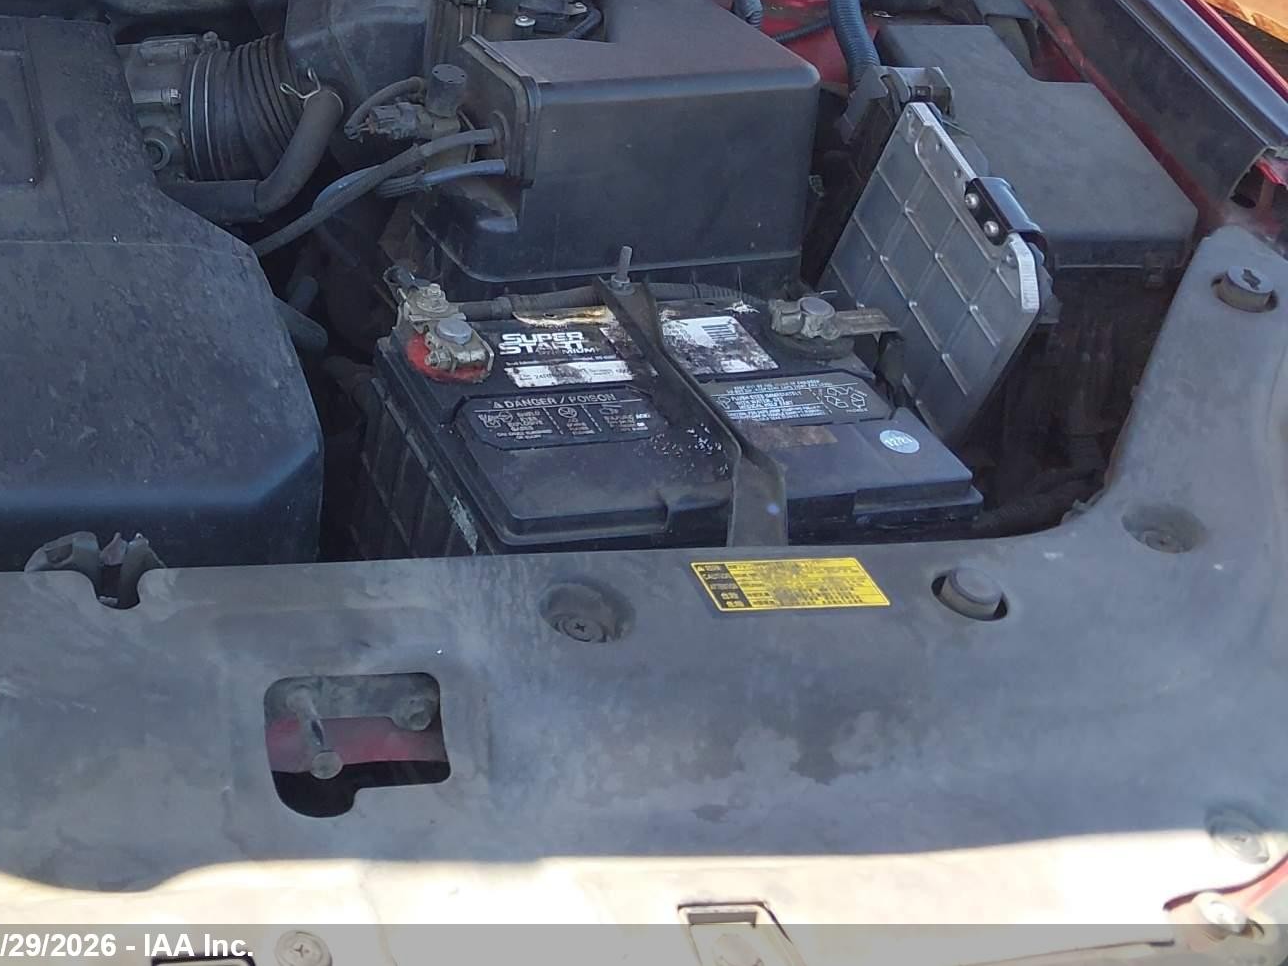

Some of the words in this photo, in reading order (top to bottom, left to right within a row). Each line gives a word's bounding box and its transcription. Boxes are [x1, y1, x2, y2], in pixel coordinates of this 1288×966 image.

[502, 331, 584, 343] SUPER
[499, 341, 583, 355] START
[504, 397, 556, 409] DANGER
[568, 393, 617, 404] POISON
